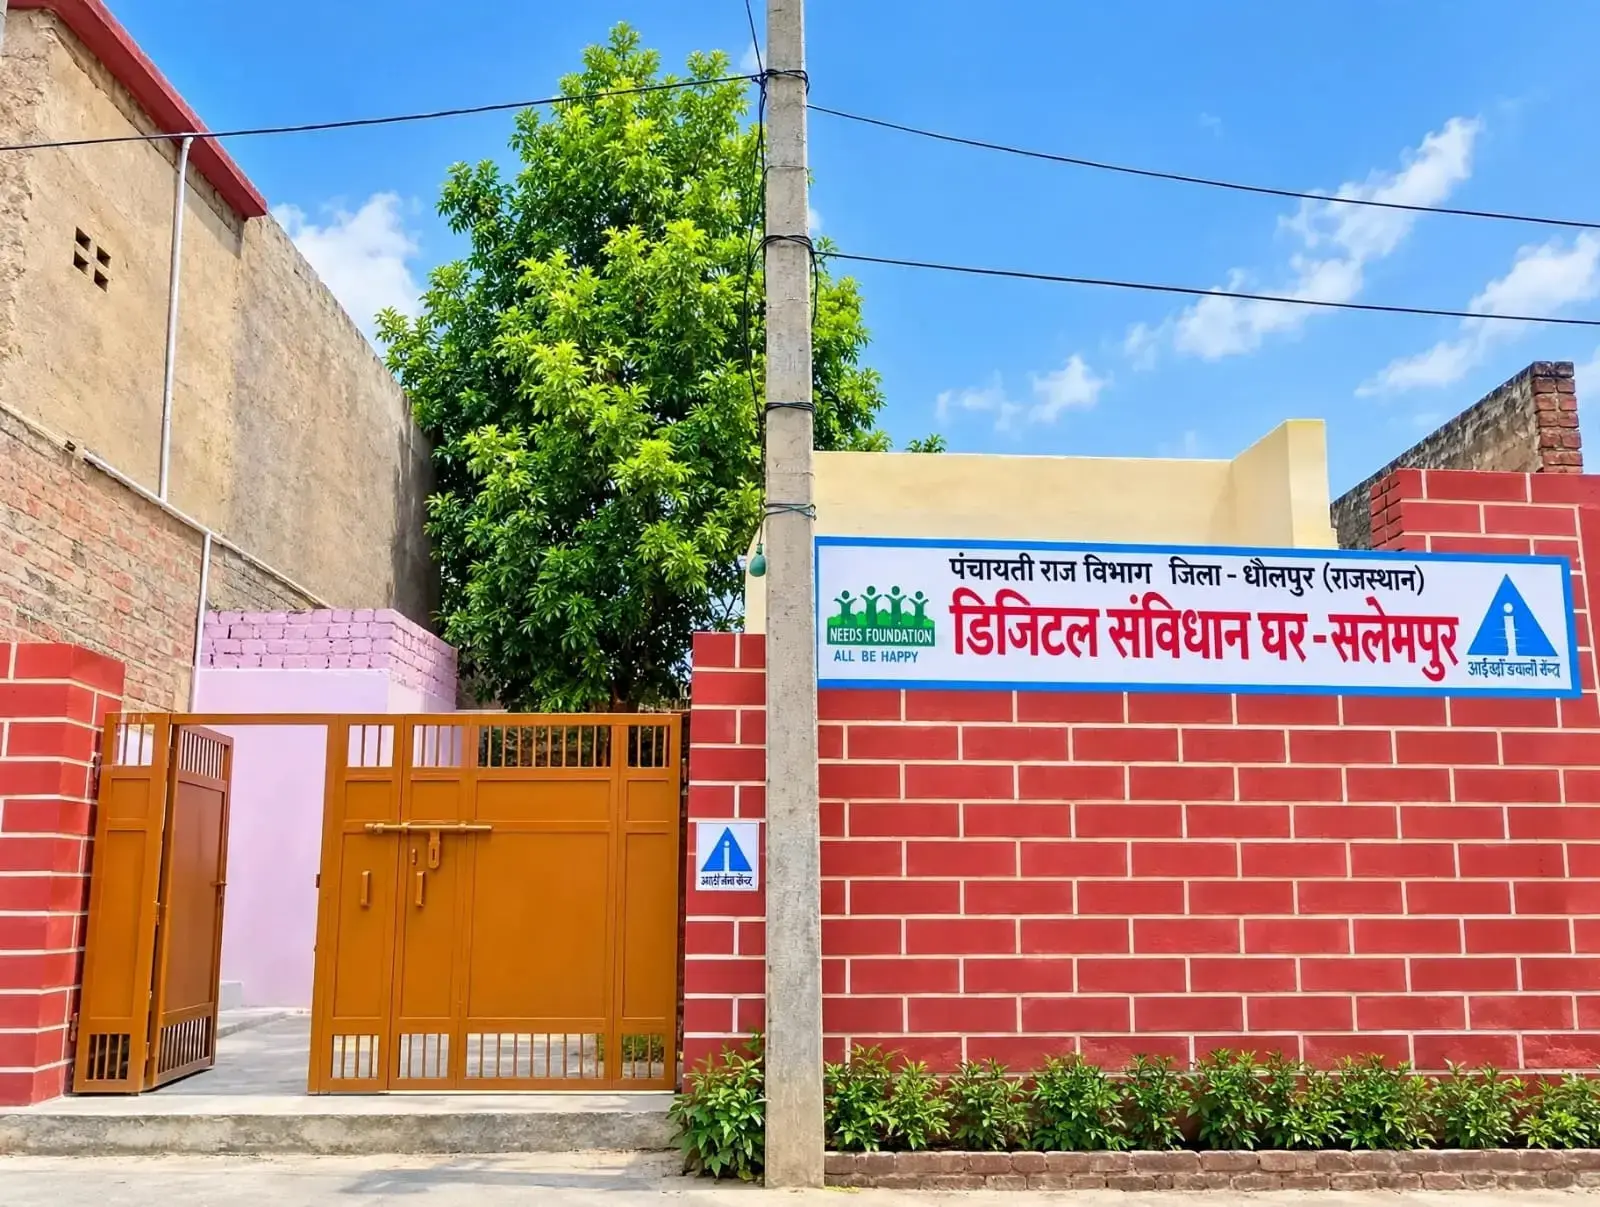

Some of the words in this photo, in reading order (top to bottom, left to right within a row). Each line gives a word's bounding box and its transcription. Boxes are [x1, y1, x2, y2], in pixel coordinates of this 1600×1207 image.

[949, 552, 1035, 582] पंचायती
[1040, 561, 1077, 582] राज
[1083, 554, 1153, 584] विभाग
[1169, 556, 1222, 586] जिला
[1243, 558, 1315, 597] धौलपुर
[1323, 562, 1425, 596] (राजस्थान)
[830, 628, 862, 642] NEEDS
[866, 628, 932, 643] FOUNDATION
[950, 587, 1100, 657] डिजिटल
[1107, 593, 1250, 660] संविधान
[834, 650, 855, 662] ALL
[861, 650, 877, 662] BE
[881, 651, 919, 663] HAPPY
